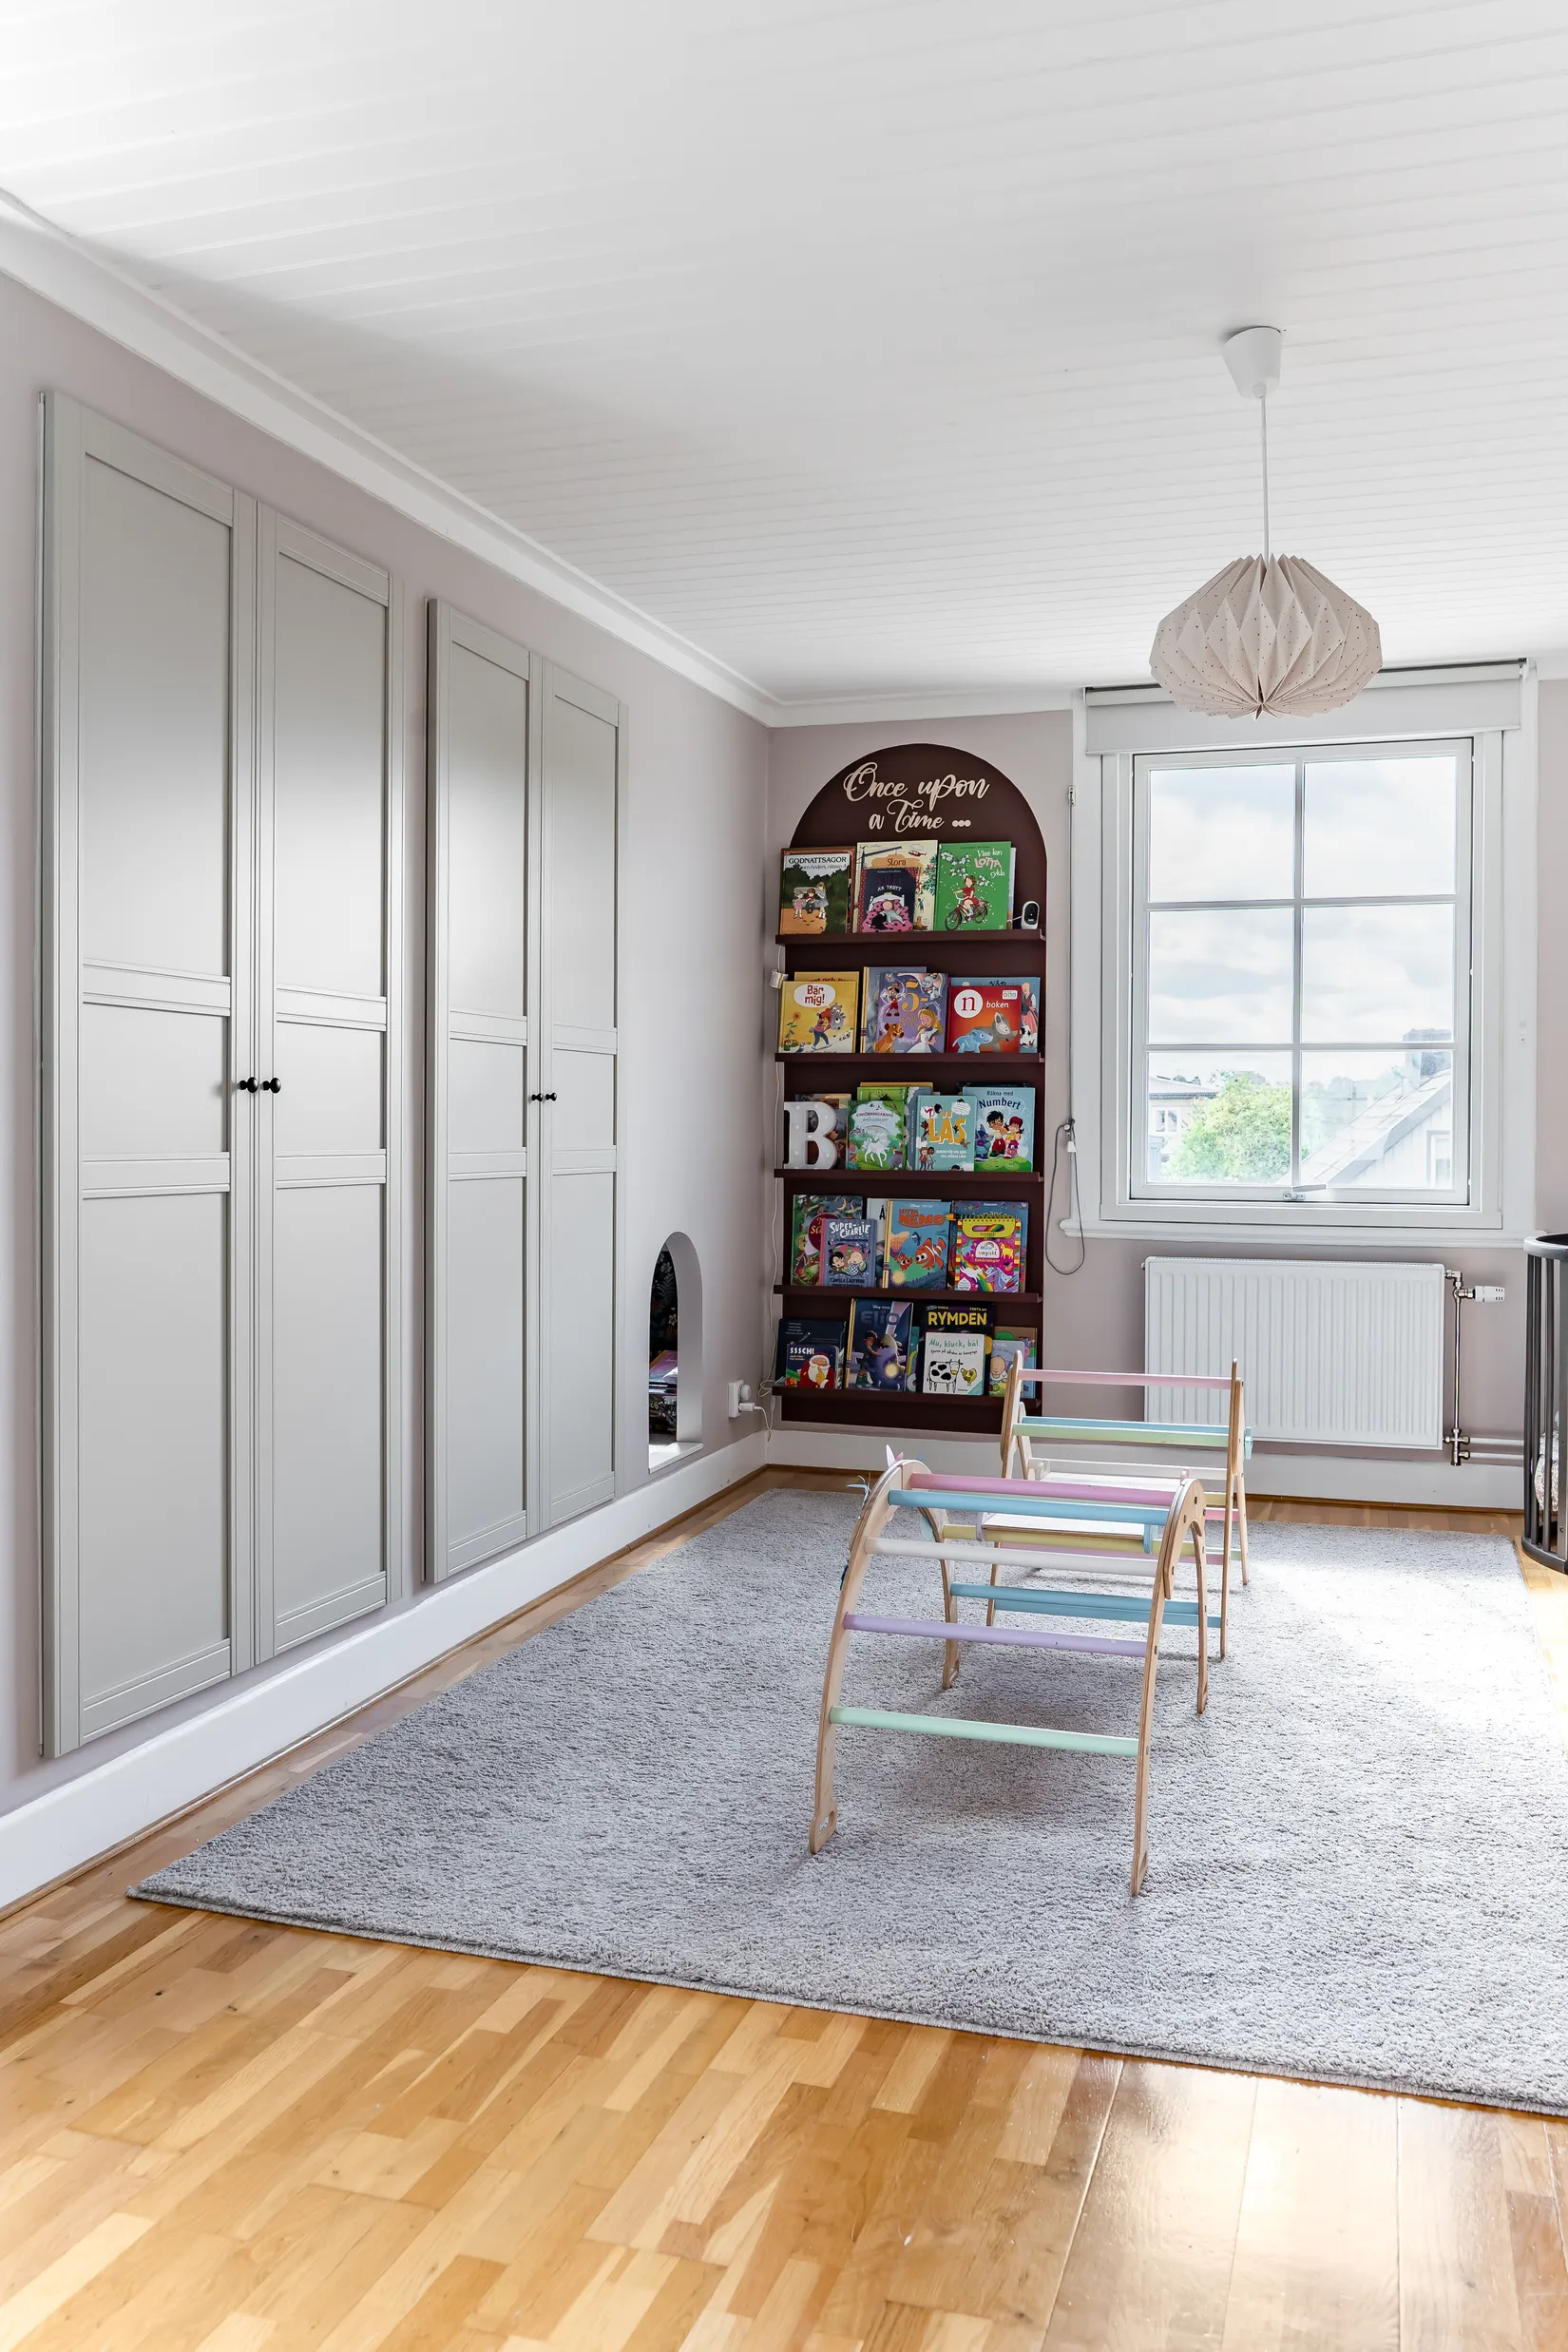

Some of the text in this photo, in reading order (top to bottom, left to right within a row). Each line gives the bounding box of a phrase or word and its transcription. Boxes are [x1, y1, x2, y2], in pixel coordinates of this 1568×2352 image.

[843, 761, 989, 812] Once upon
[869, 813, 885, 830] a
[887, 857, 907, 867] Stora
[974, 856, 1003, 870] LOTTA
[807, 985, 824, 995] Bär
[805, 994, 825, 1006] mig!
[978, 1098, 1022, 1110] Numbert
[928, 1111, 966, 1144] LÄS
[784, 1101, 837, 1169] B
[898, 1214, 946, 1226] NEMO
[839, 1221, 870, 1238] CHARLIE
[927, 1311, 987, 1326] RYMDEN
[928, 1339, 942, 1348] Mu,
[944, 1339, 966, 1348] kluck,
[790, 1347, 814, 1355] SSSCH!
